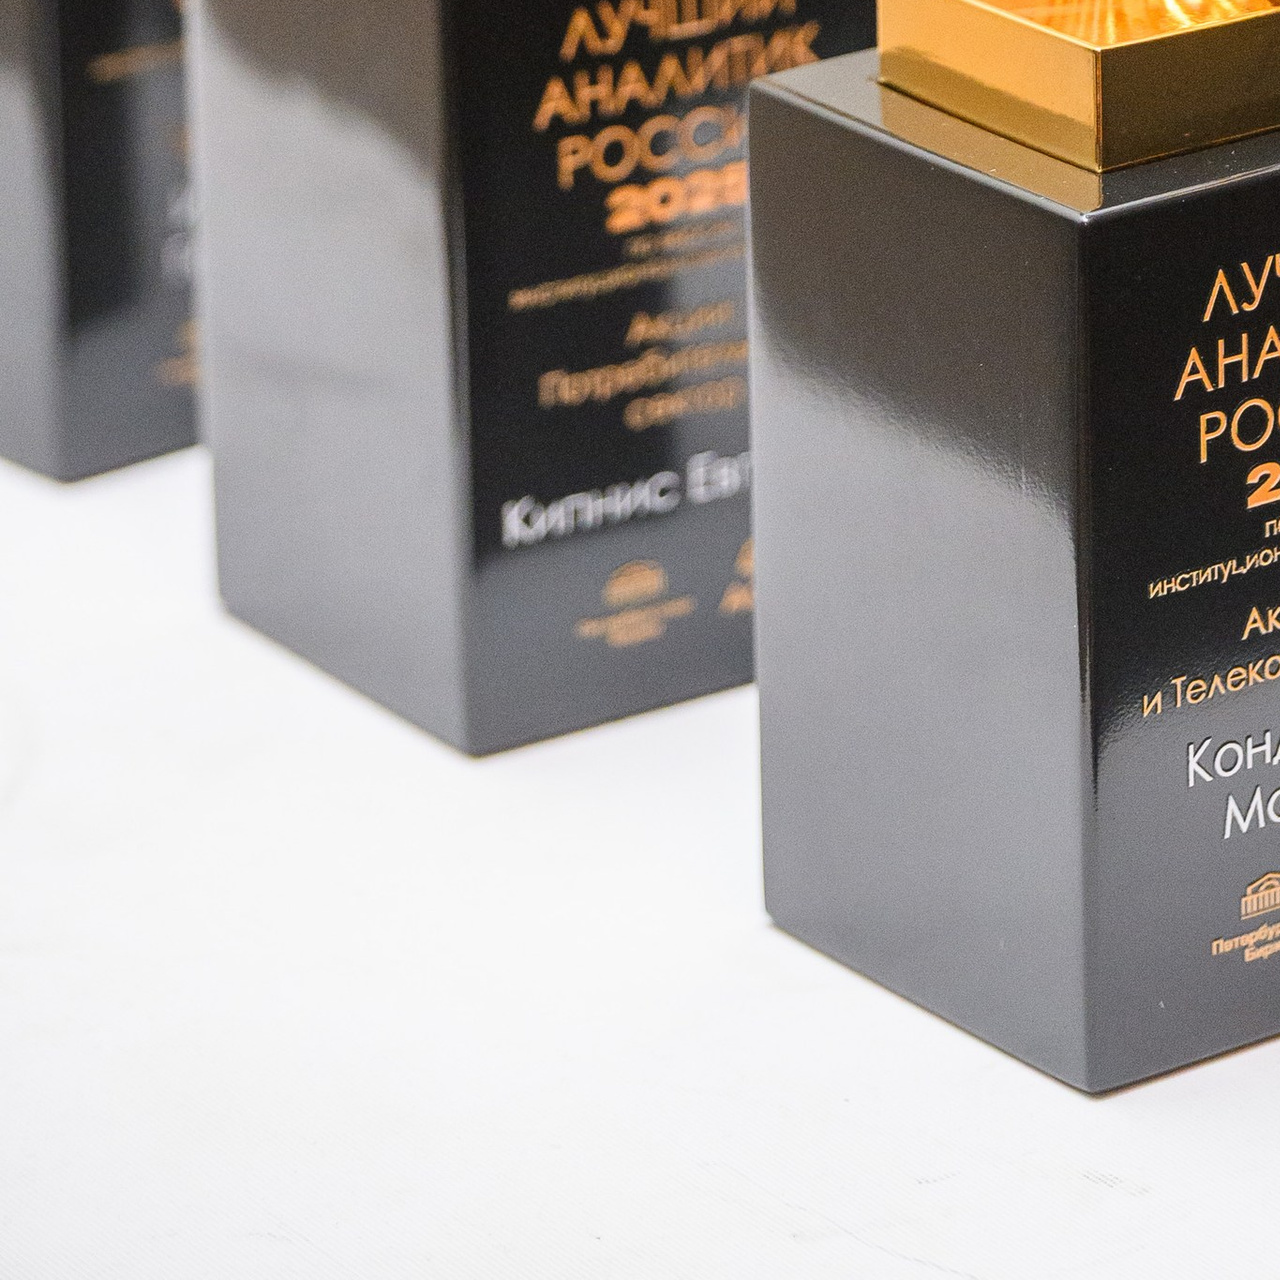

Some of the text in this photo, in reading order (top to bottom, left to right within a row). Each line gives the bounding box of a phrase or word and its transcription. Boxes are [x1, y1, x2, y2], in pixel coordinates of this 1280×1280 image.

[532, 21, 822, 132] АНАЛИТИК
[556, 104, 749, 192] РОССИ
[501, 470, 681, 549] Кипнис
[1142, 691, 1162, 718] и
